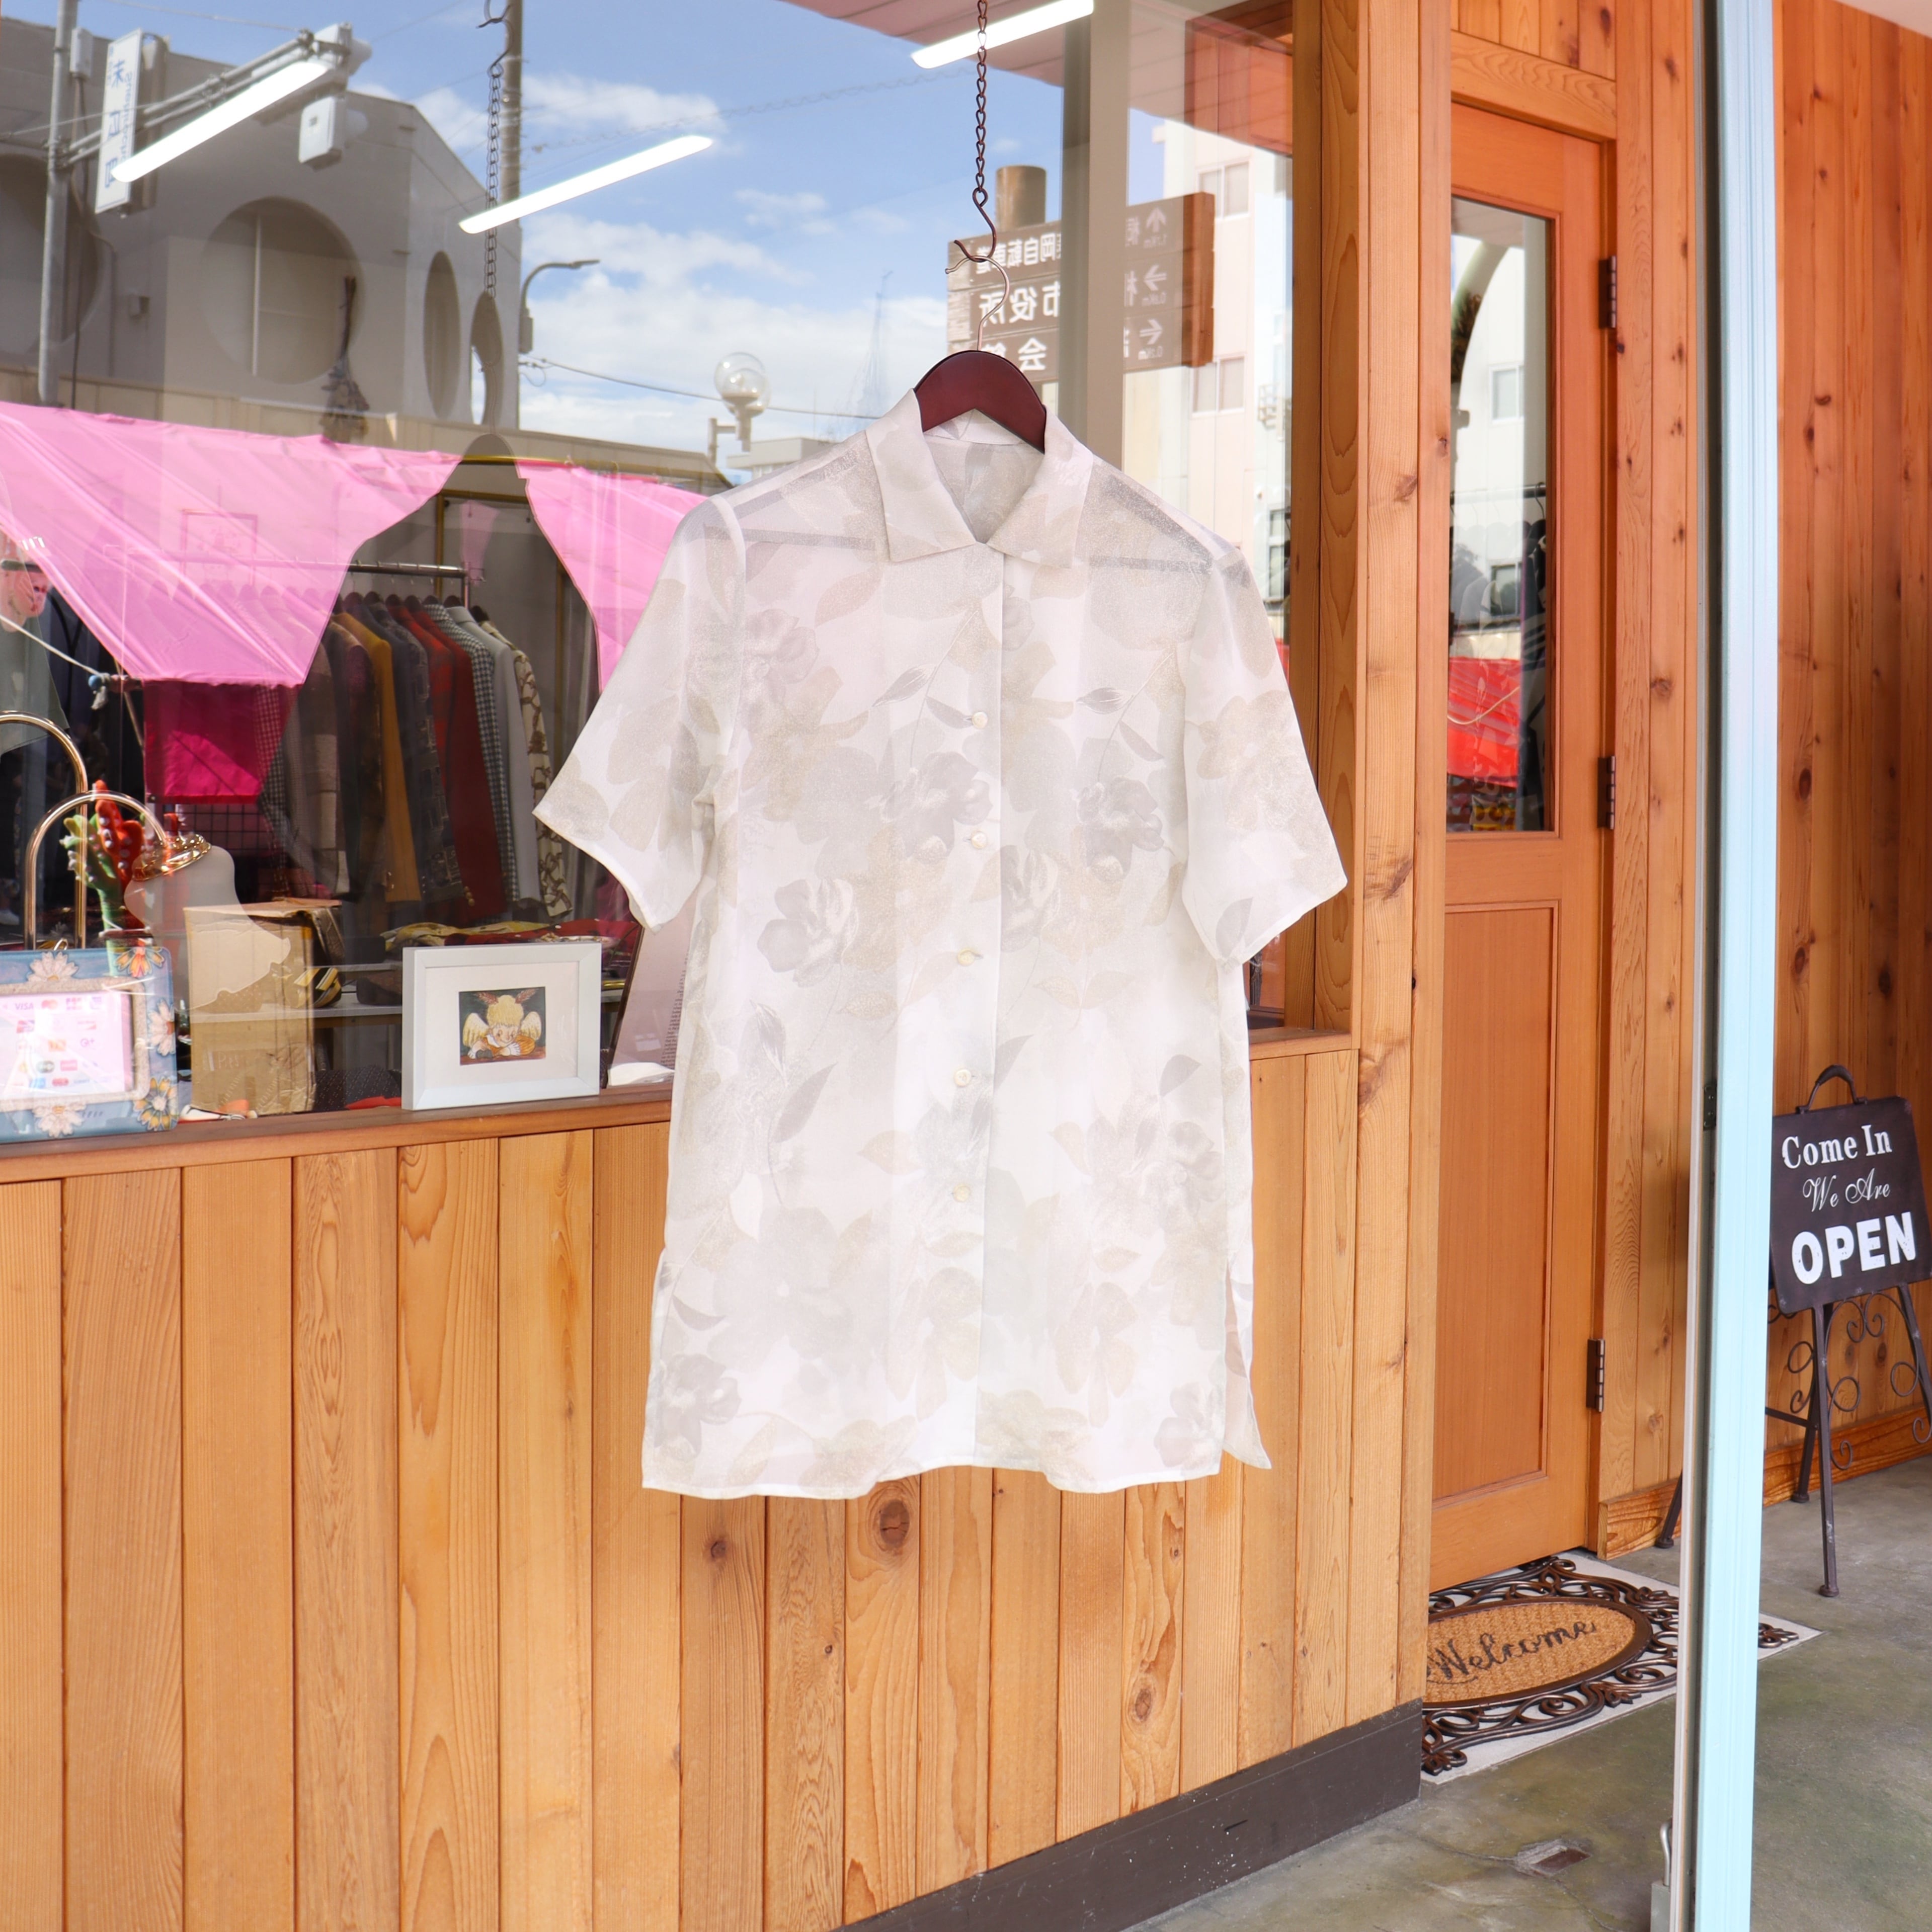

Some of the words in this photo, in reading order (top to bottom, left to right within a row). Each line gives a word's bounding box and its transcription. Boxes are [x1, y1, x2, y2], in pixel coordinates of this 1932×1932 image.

[15, 1002, 34, 1010] VISA
[1782, 1136, 1858, 1169] Come
[1861, 1124, 1893, 1157] In
[1803, 1175, 1839, 1213] We
[1845, 1168, 1891, 1204] Are
[1791, 1211, 1916, 1285] OPEN
[1426, 1620, 1596, 1683] Welcome
